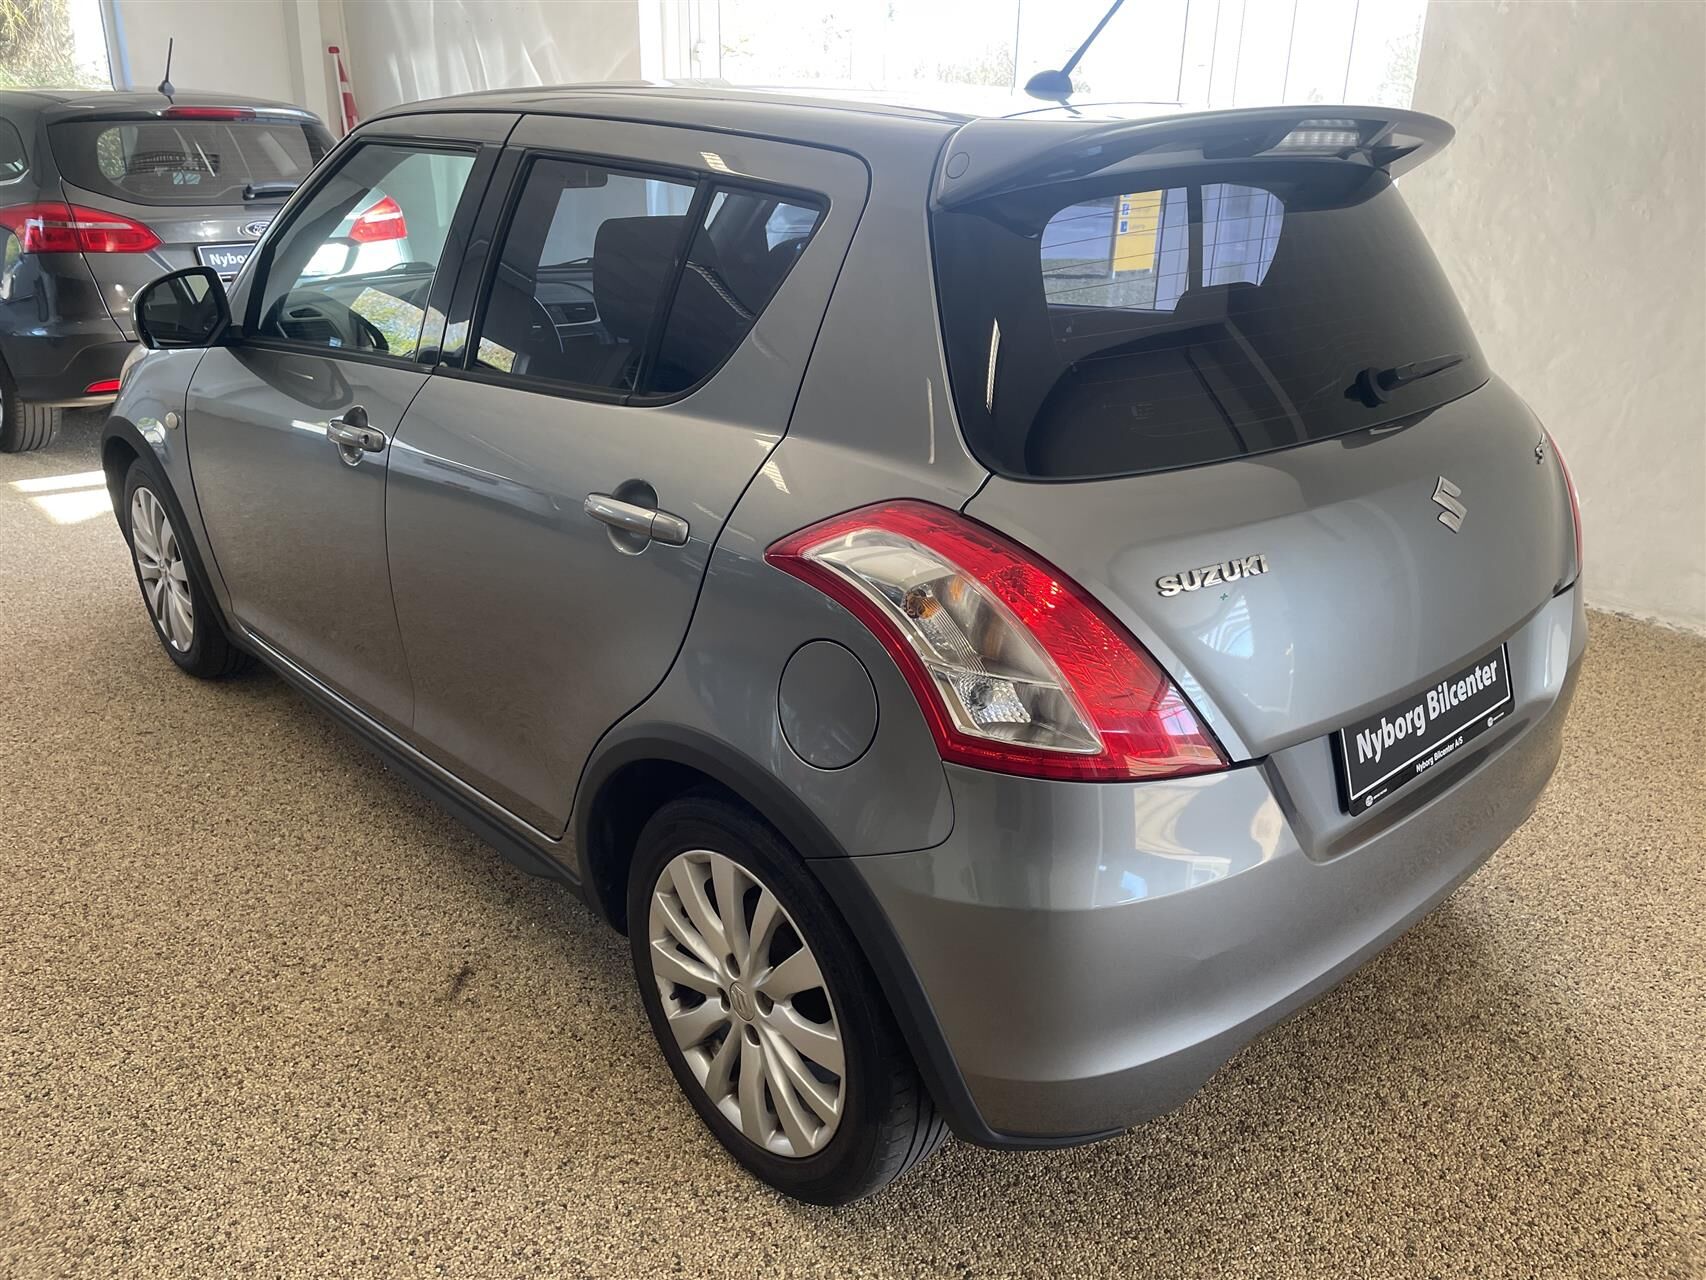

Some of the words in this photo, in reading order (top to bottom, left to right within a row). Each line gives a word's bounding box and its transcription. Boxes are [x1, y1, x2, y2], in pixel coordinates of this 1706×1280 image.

[209, 253, 248, 267] Nybo
[1157, 554, 1269, 597] SUZUKI
[1356, 704, 1426, 763] Nyborg
[1426, 660, 1498, 721] Bilcenter
[1415, 756, 1434, 772] Nyborg
[1433, 742, 1455, 761] Bilcenter
